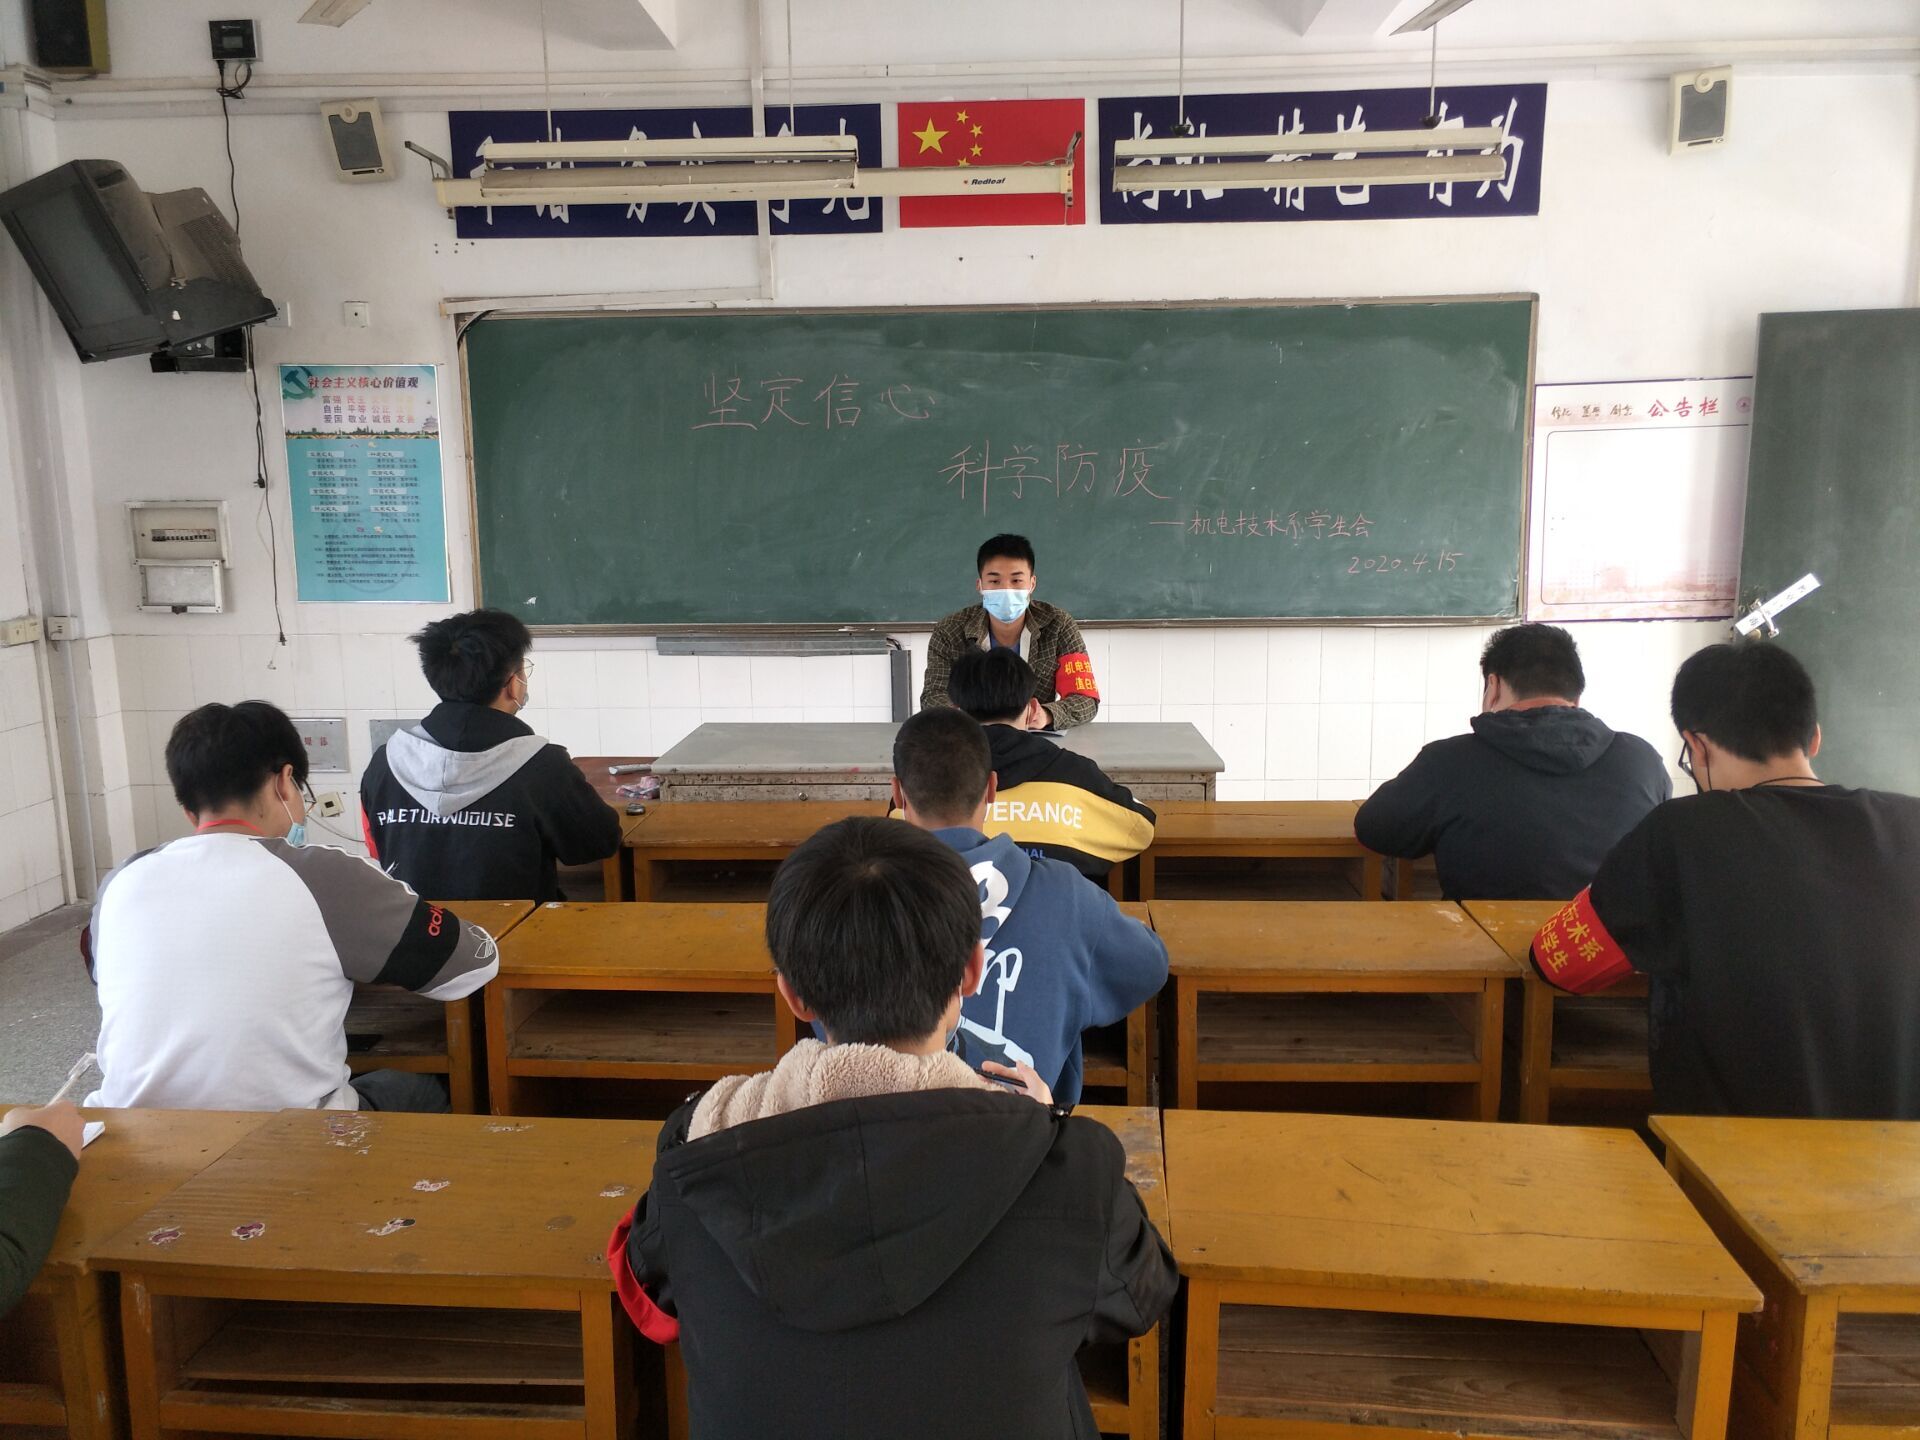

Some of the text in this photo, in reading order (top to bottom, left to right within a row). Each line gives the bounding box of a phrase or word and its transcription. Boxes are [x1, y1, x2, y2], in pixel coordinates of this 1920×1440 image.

[971, 177, 1006, 186] Redleaf
[308, 375, 419, 390] 社会主义核心价值观
[691, 371, 936, 430] 坚定信心
[1647, 396, 1719, 418] 公告栏
[938, 438, 1172, 518] 科学防疫
[1347, 549, 1463, 575] 2020.4.15
[1557, 902, 1604, 963] 技术系
